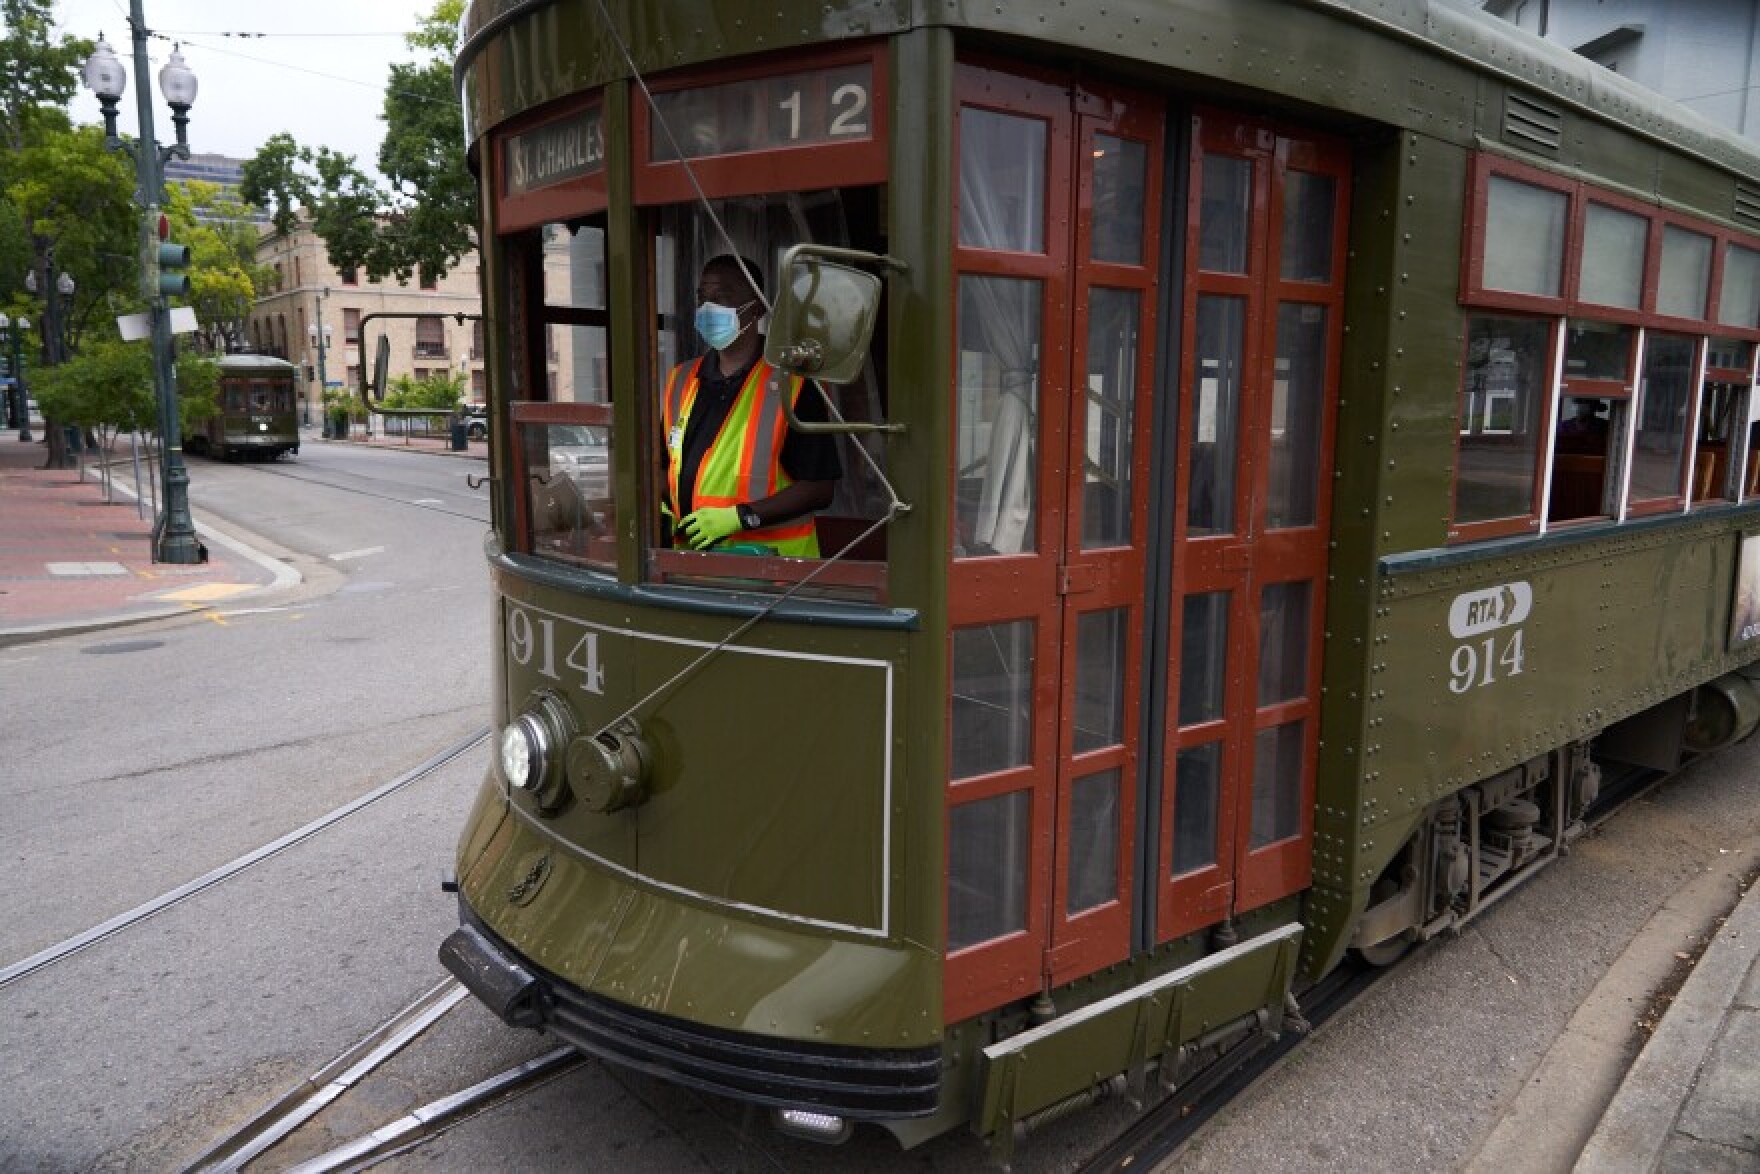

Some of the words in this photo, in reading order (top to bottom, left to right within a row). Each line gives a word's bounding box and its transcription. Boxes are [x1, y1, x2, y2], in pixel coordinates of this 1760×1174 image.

[536, 122, 604, 179] CHARLES
[1466, 596, 1497, 626] RTA
[510, 608, 604, 695] 914
[1449, 629, 1524, 693] 914
